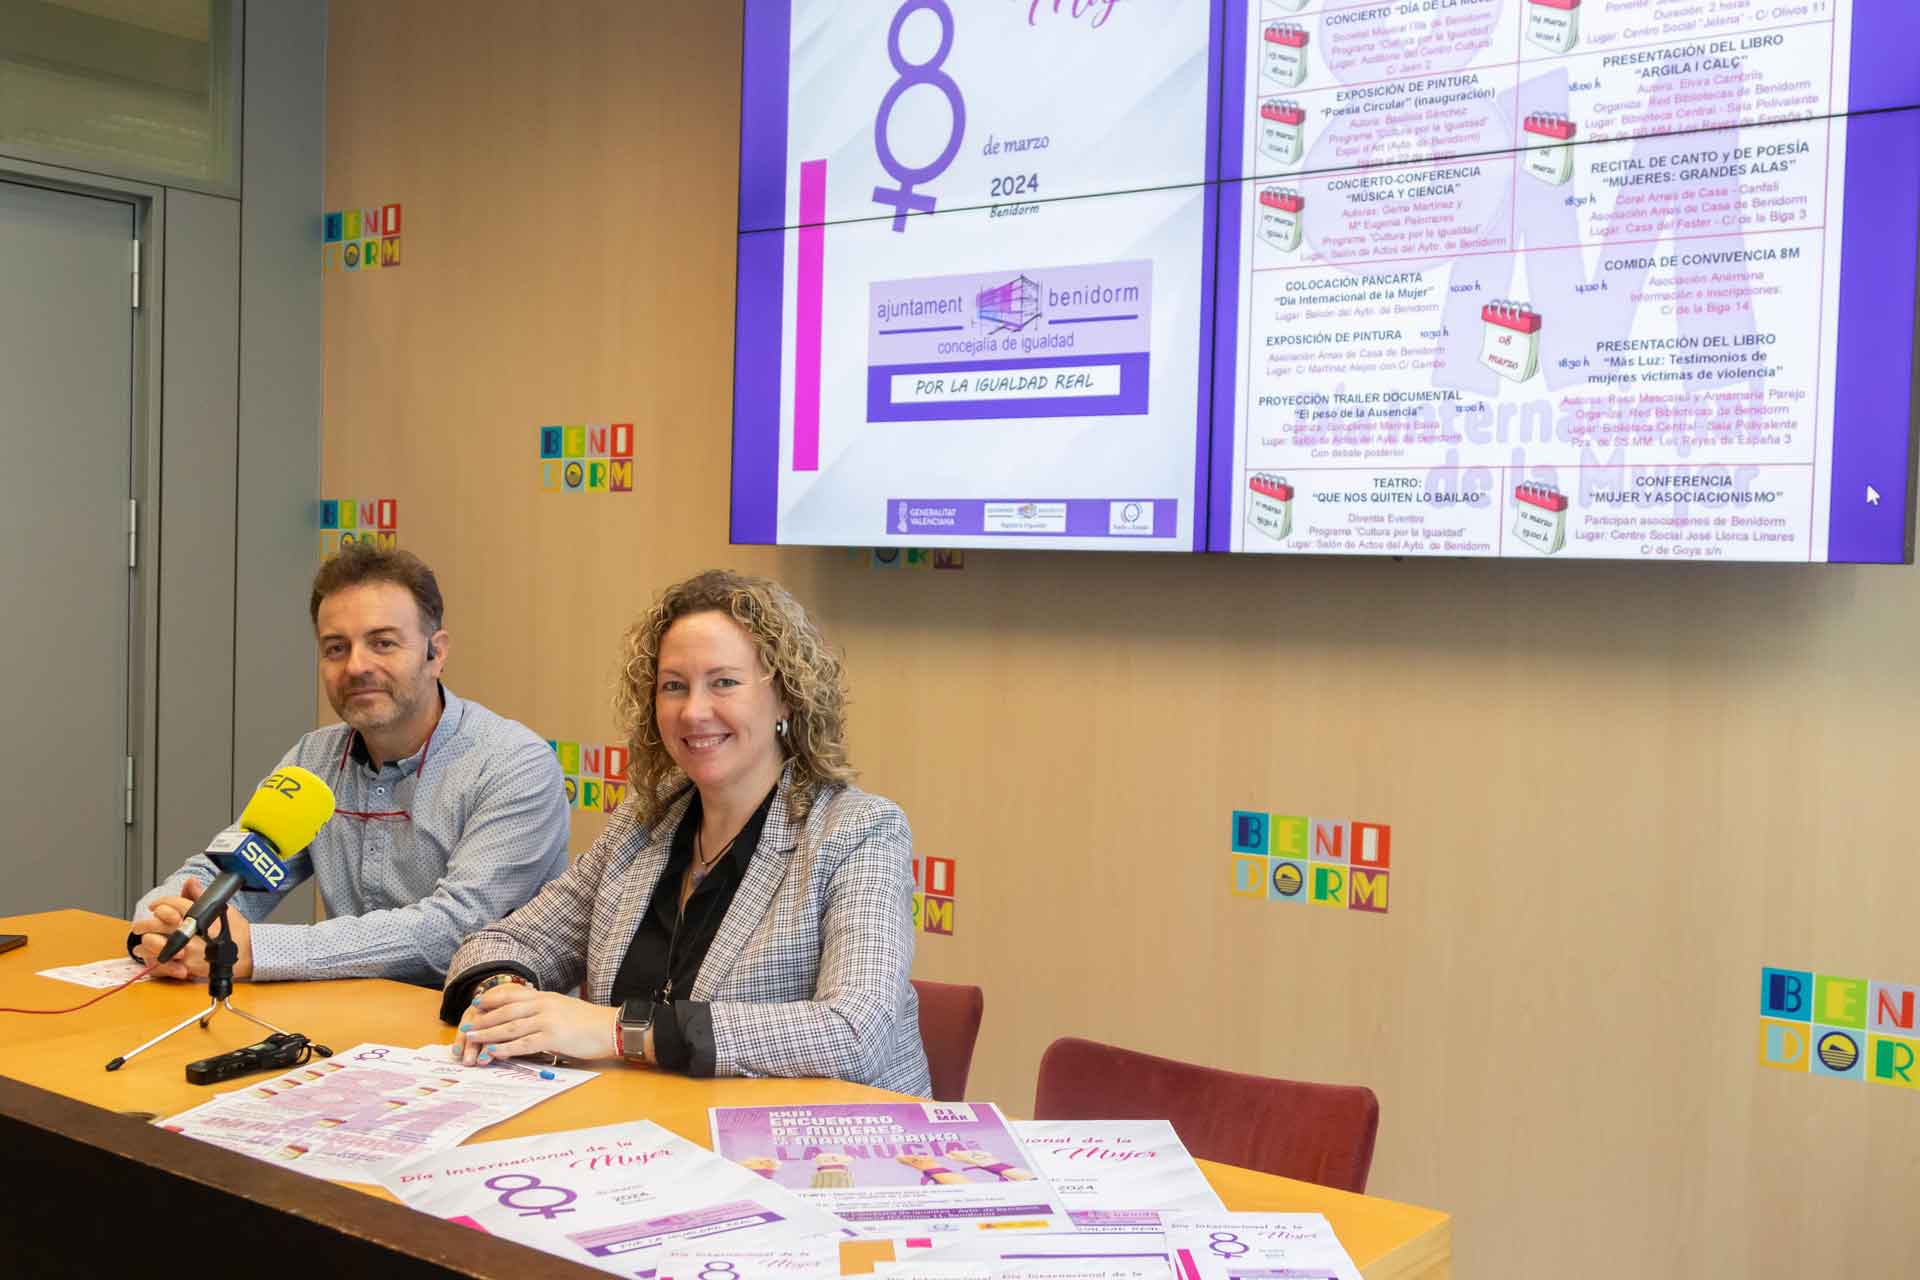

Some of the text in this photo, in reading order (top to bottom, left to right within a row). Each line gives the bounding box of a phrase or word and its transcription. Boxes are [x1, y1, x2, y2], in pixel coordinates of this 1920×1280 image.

[1326, 7, 1391, 26] CONCIERTO
[1423, 0, 1438, 11] DE
[1602, 33, 1784, 68] PRESENTACIÓN DEL LIBRO
[1635, 61, 1691, 80] “ARGILA
[1336, 73, 1479, 102] EXPOSICIÓN DE PINTURA
[1413, 87, 1496, 108] (inauguración)
[983, 134, 1050, 156] de marzo
[1590, 158, 1644, 176] RECITAL
[1649, 156, 1667, 168] DE
[1671, 151, 1719, 167] CANTO
[1733, 147, 1753, 160] DE
[1756, 142, 1810, 158] POESÍA
[1603, 159, 1797, 188] “MUJERES: GRANDES ALAS”
[989, 173, 1040, 197] 2024
[1398, 188, 1406, 200] Y
[1407, 183, 1462, 199] CIENCIA”
[988, 202, 1041, 219] Benidorm
[1604, 248, 1801, 272] COMIDA DE CONVIVENCIA 8M
[1285, 271, 1423, 292] COLOCACIÓN PANCARTA
[877, 284, 1140, 322] ajuntament benidorm
[1299, 291, 1367, 306] Internacional
[1369, 290, 1383, 301] de
[1385, 289, 1395, 300] la
[1001, 335, 1018, 350] de
[1020, 332, 1074, 353] igualdad
[1266, 329, 1403, 346] EXPOSICIÓN DE PINTURA
[1497, 335, 1513, 347] 08
[1596, 333, 1777, 353] PRESENTACIÓN DEL LIBRO
[1487, 353, 1520, 370] marzo
[1638, 354, 1666, 367] Luz:
[1669, 351, 1749, 366] Testimonios
[1752, 350, 1768, 363] de
[1588, 363, 1784, 385] mujeres víctimas de violencia”
[915, 372, 1094, 395] POR LA IGUALDAD REAL
[1258, 389, 1463, 408] PROYECCIÓN TRAILER DOCUMENTAL
[1312, 410, 1338, 422] peso
[1340, 408, 1354, 420] de
[1355, 408, 1366, 420] la
[1367, 404, 1425, 418] Ausencia”
[543, 427, 627, 455] BENI
[1373, 477, 1422, 489] TEATRO:
[1635, 475, 1733, 487] CONFERENCIA
[1312, 491, 1487, 504] “QUE NOS QUITEN LO BAILAO”
[1589, 490, 1785, 504] “MUJER Y ASOCIACIONISMO”
[910, 508, 957, 518] GENERALITAT
[1584, 514, 1637, 528] Participan
[1712, 514, 1728, 526] de
[1730, 514, 1786, 527] Benidorm
[910, 518, 956, 528] VALENCIANA
[1393, 527, 1408, 540] por
[1648, 530, 1683, 542] Social
[1753, 530, 1796, 543] Linares
[1345, 540, 1357, 551] de
[1386, 540, 1401, 552] del
[1444, 541, 1491, 554] Benidorm
[1655, 545, 1670, 557] de
[1237, 815, 1378, 863] BENI
[771, 1115, 893, 1127] ENCUENTRO
[773, 1124, 905, 1138] DE MUJERES
[1116, 1136, 1133, 1144] la
[446, 1149, 575, 1177] Internacional
[586, 1144, 609, 1154] de
[616, 1139, 634, 1149] la
[569, 1148, 673, 1171] Mujer
[1053, 1147, 1158, 1161] Mujer
